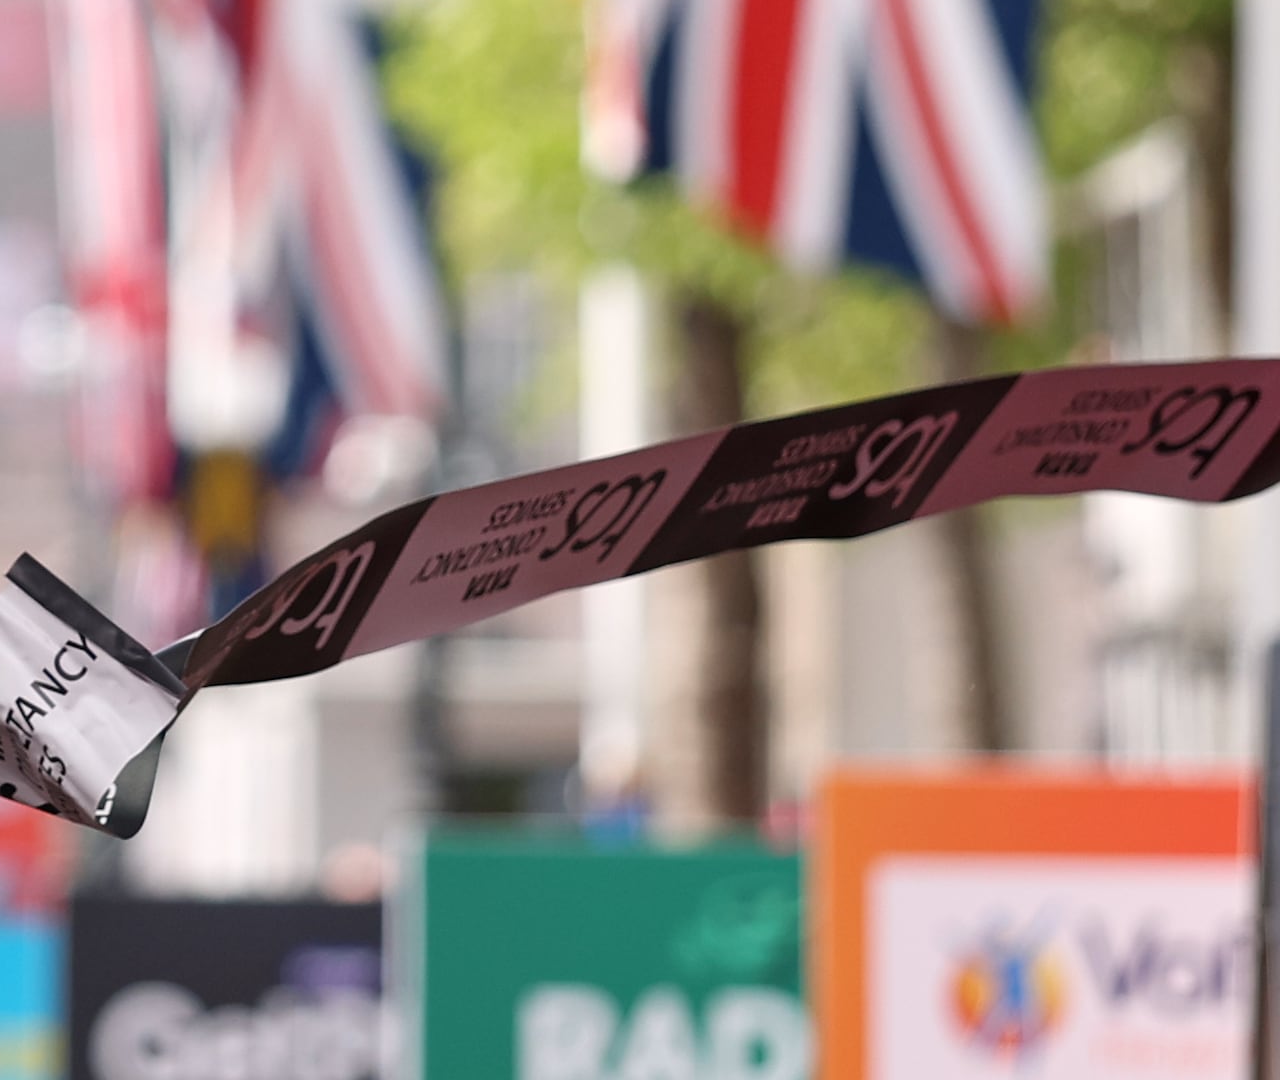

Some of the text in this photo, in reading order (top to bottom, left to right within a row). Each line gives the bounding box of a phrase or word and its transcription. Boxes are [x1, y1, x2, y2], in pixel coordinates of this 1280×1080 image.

[827, 410, 962, 510] tcs
[1118, 386, 1262, 482] tcs
[540, 469, 668, 566] tcs
